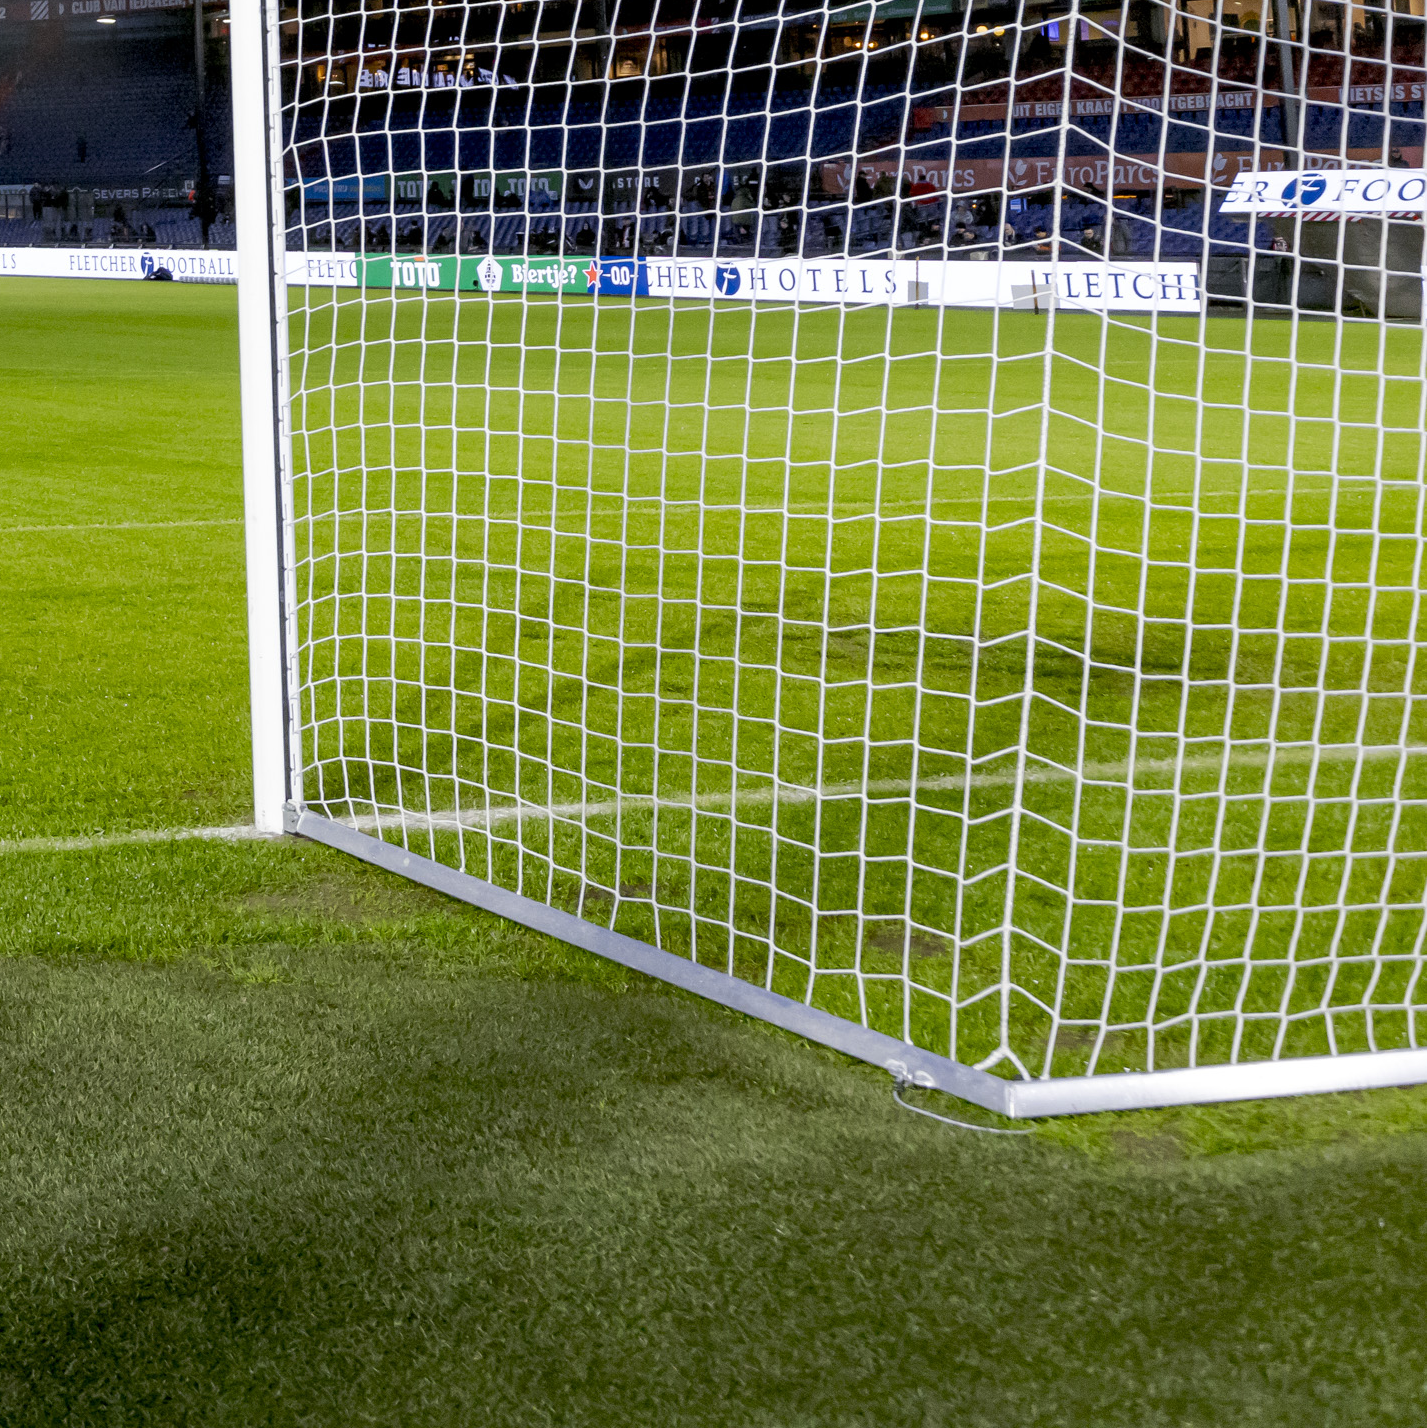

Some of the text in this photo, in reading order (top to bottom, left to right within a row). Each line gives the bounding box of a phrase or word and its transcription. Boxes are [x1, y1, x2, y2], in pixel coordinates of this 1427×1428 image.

[71, 0, 101, 15] CLUB
[70, 255, 137, 273] FLETCHER
[390, 260, 441, 288] TOTO
[511, 263, 577, 289] Biertje?
[749, 267, 897, 295] HOTELS
